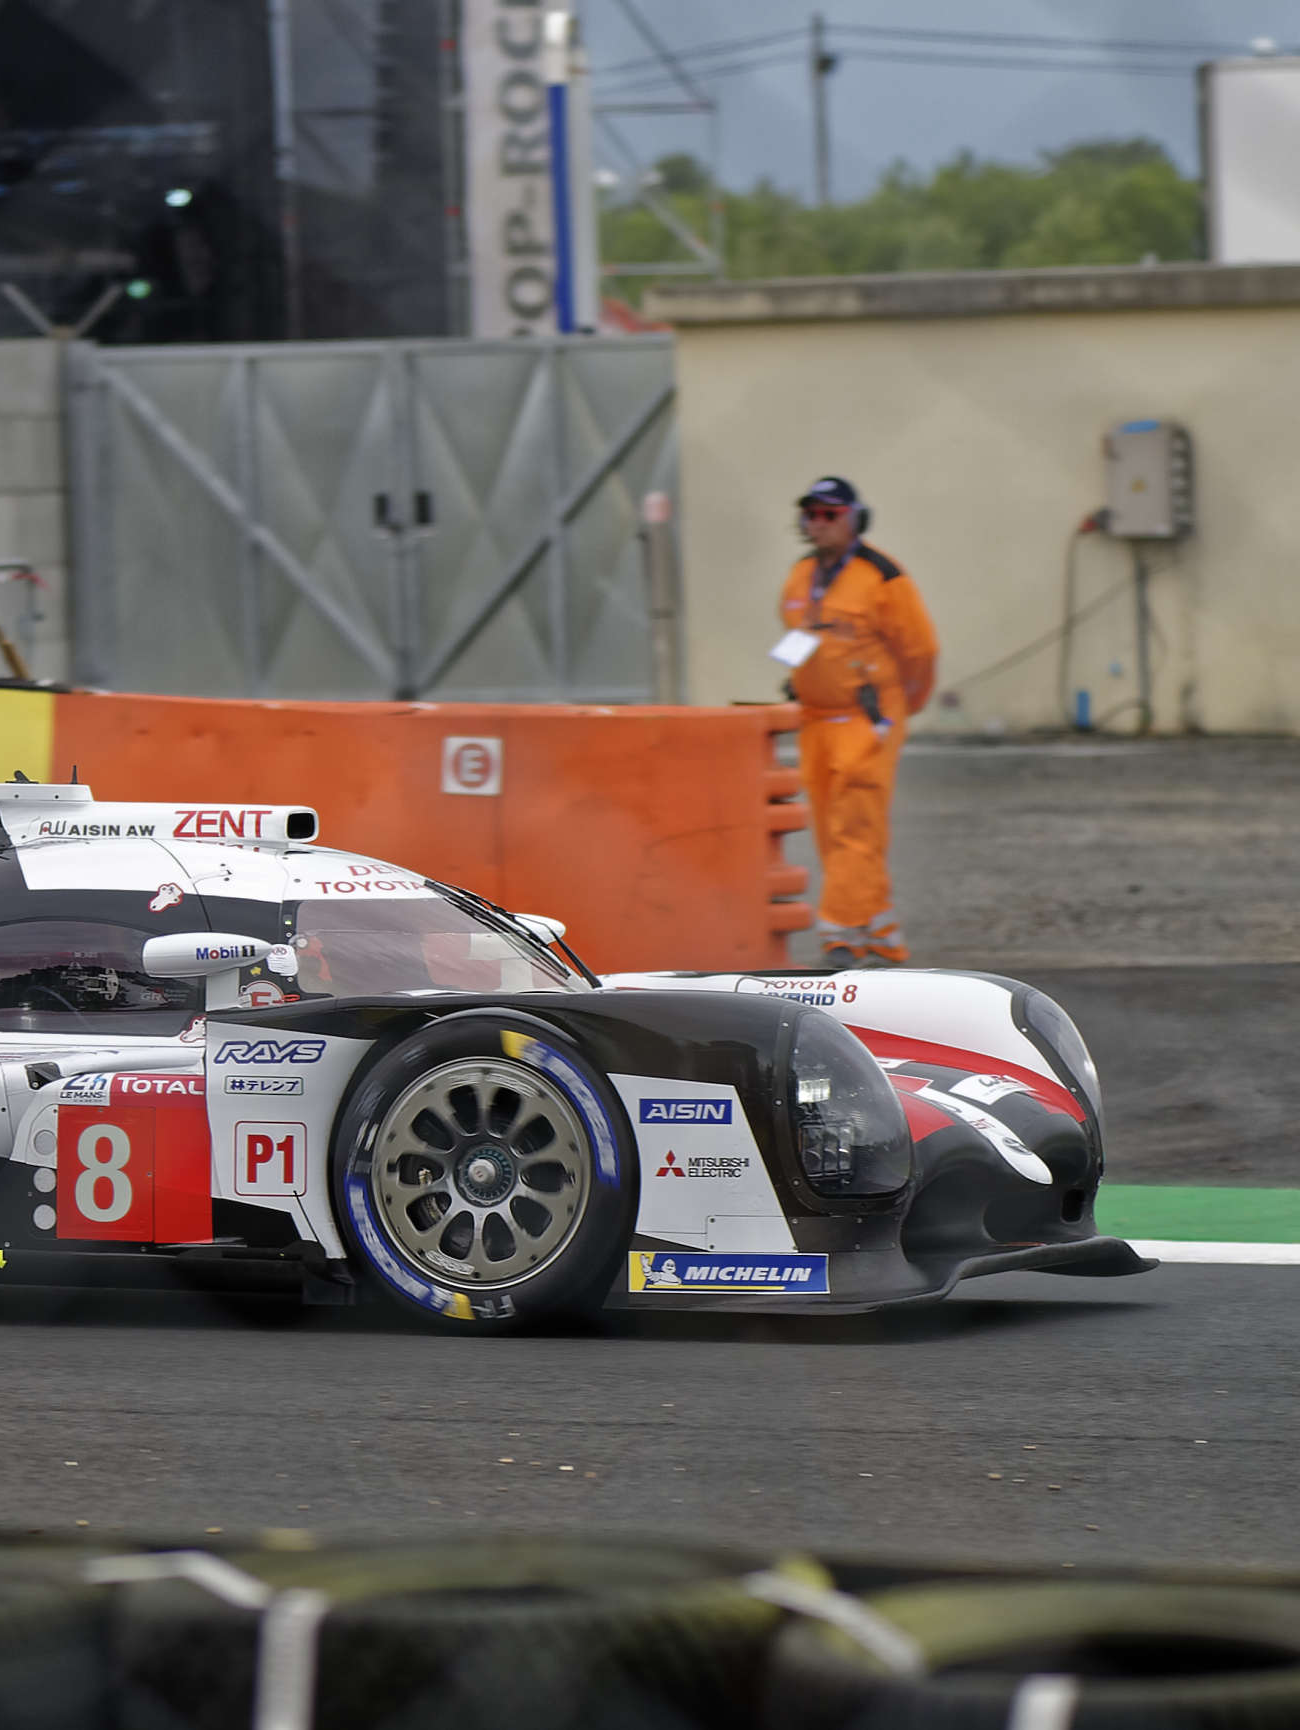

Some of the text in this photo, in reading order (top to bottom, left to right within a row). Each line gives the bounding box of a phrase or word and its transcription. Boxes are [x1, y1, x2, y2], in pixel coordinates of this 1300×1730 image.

[497, 0, 553, 338] OP-ROC
[68, 825, 121, 837] AISIN
[126, 825, 156, 837] AW
[172, 810, 272, 838] ZENT
[315, 880, 428, 894] TOYOTA
[196, 946, 238, 960] Mobil
[763, 980, 837, 991] TOYOTA
[842, 984, 858, 1003] 8
[213, 1040, 326, 1064] RAYS
[117, 1076, 205, 1095] TOTAL
[59, 1091, 104, 1099] LE MANS
[645, 1103, 726, 1120] AISIN
[246, 1134, 295, 1184] P1
[687, 1157, 750, 1168] MITSUBISHI
[74, 1123, 133, 1223] 8
[688, 1168, 742, 1178] ELECTRIC
[683, 1266, 812, 1282] MICHELIN
